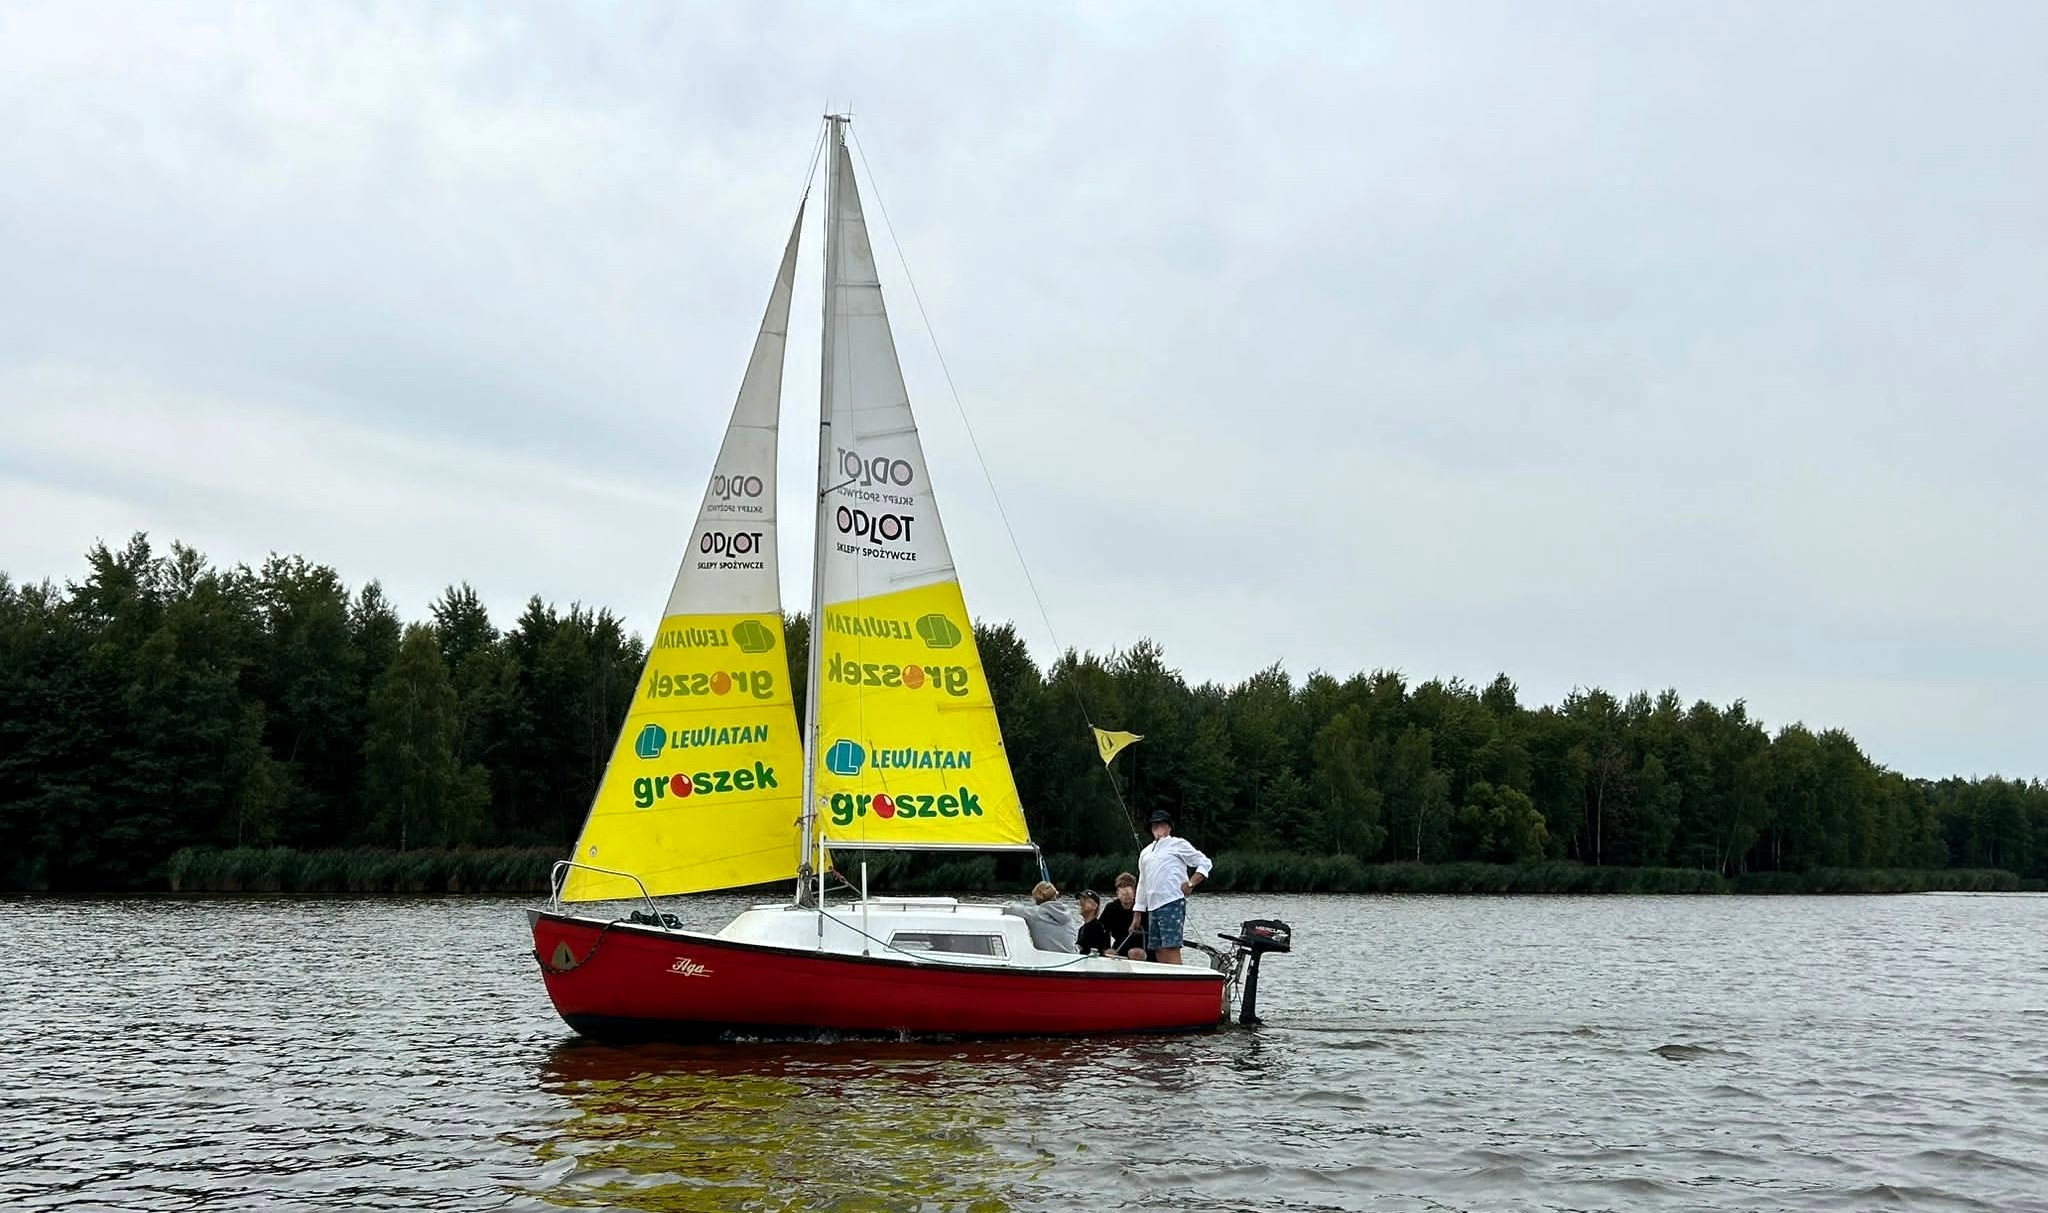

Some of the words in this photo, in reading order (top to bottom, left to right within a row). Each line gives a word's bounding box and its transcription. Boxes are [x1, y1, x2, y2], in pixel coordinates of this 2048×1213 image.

[836, 505, 915, 545] ODLOT
[700, 532, 763, 558] ODLOT
[836, 542, 860, 555] SKLEPY
[862, 547, 917, 561] SPOŻYWCZE
[719, 560, 764, 569] SPOŻYWCZE
[671, 725, 768, 749] LEWIATAN
[871, 748, 972, 769] LEWIATAN
[634, 761, 778, 808] groszek
[831, 786, 984, 826] groszek
